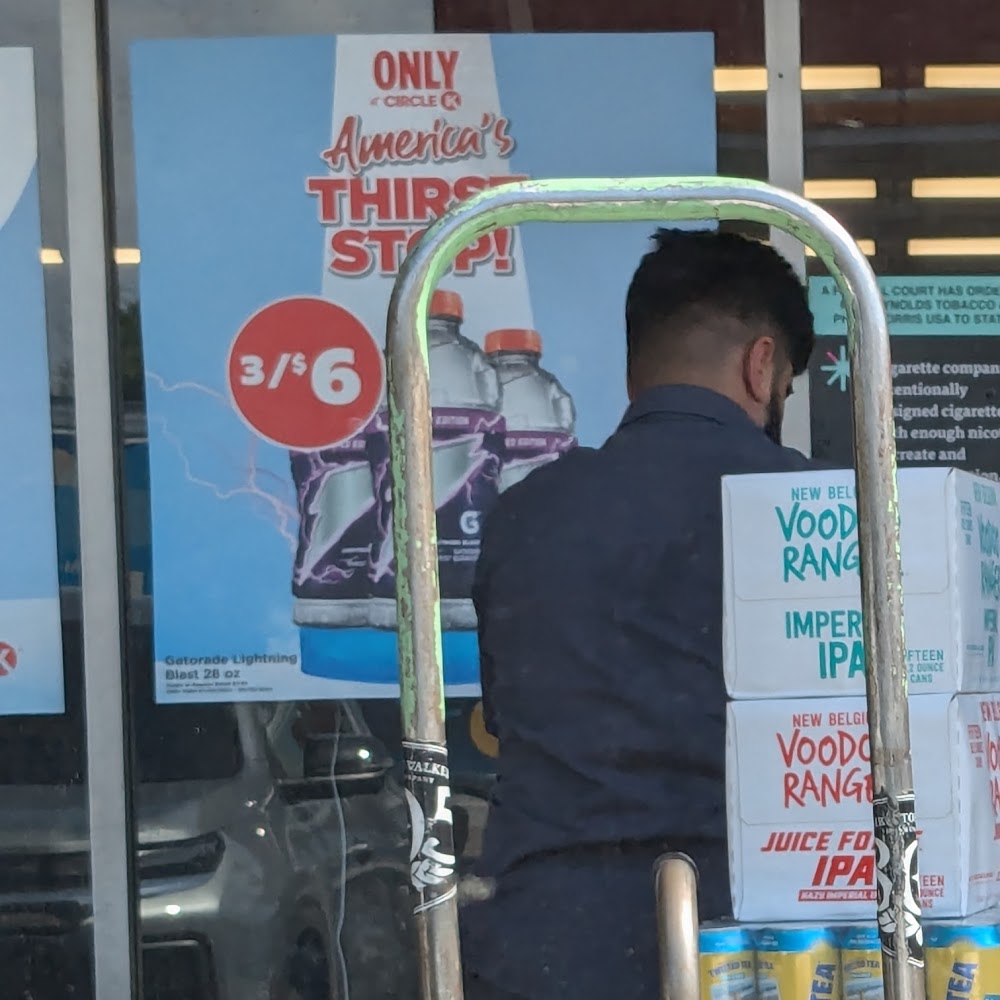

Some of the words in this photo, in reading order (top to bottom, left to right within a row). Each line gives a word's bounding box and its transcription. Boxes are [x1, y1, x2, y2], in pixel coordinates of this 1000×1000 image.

[373, 50, 459, 91] ONLY
[383, 95, 437, 107] CIRCLE
[440, 90, 462, 111] K
[322, 112, 512, 171] America's
[308, 175, 526, 222] THIRS
[891, 286, 935, 296] COURT
[938, 286, 964, 296] HAS
[884, 300, 932, 311] YNOLDS
[936, 300, 996, 310] TOBACCO
[889, 313, 923, 324] ORRIS
[926, 313, 952, 324] USA
[954, 313, 971, 324] TO
[892, 362, 940, 378] garette
[894, 382, 969, 399] entionally
[893, 404, 939, 420] signed
[910, 425, 965, 442] enough
[938, 446, 966, 461] and
[791, 487, 821, 500] NEW
[775, 501, 857, 542] VOOD
[783, 540, 861, 583] RANG
[785, 610, 862, 639] IMPER
[165, 654, 229, 666] Gatorade
[233, 653, 298, 666] Lightning
[819, 640, 866, 679] IPA
[166, 669, 199, 680] Blast
[224, 670, 241, 679] oz
[792, 713, 822, 727] NEW
[828, 711, 869, 726] BELGI
[776, 728, 871, 768] VOODO
[761, 831, 833, 852] JUICE
[812, 855, 875, 887] IPA
